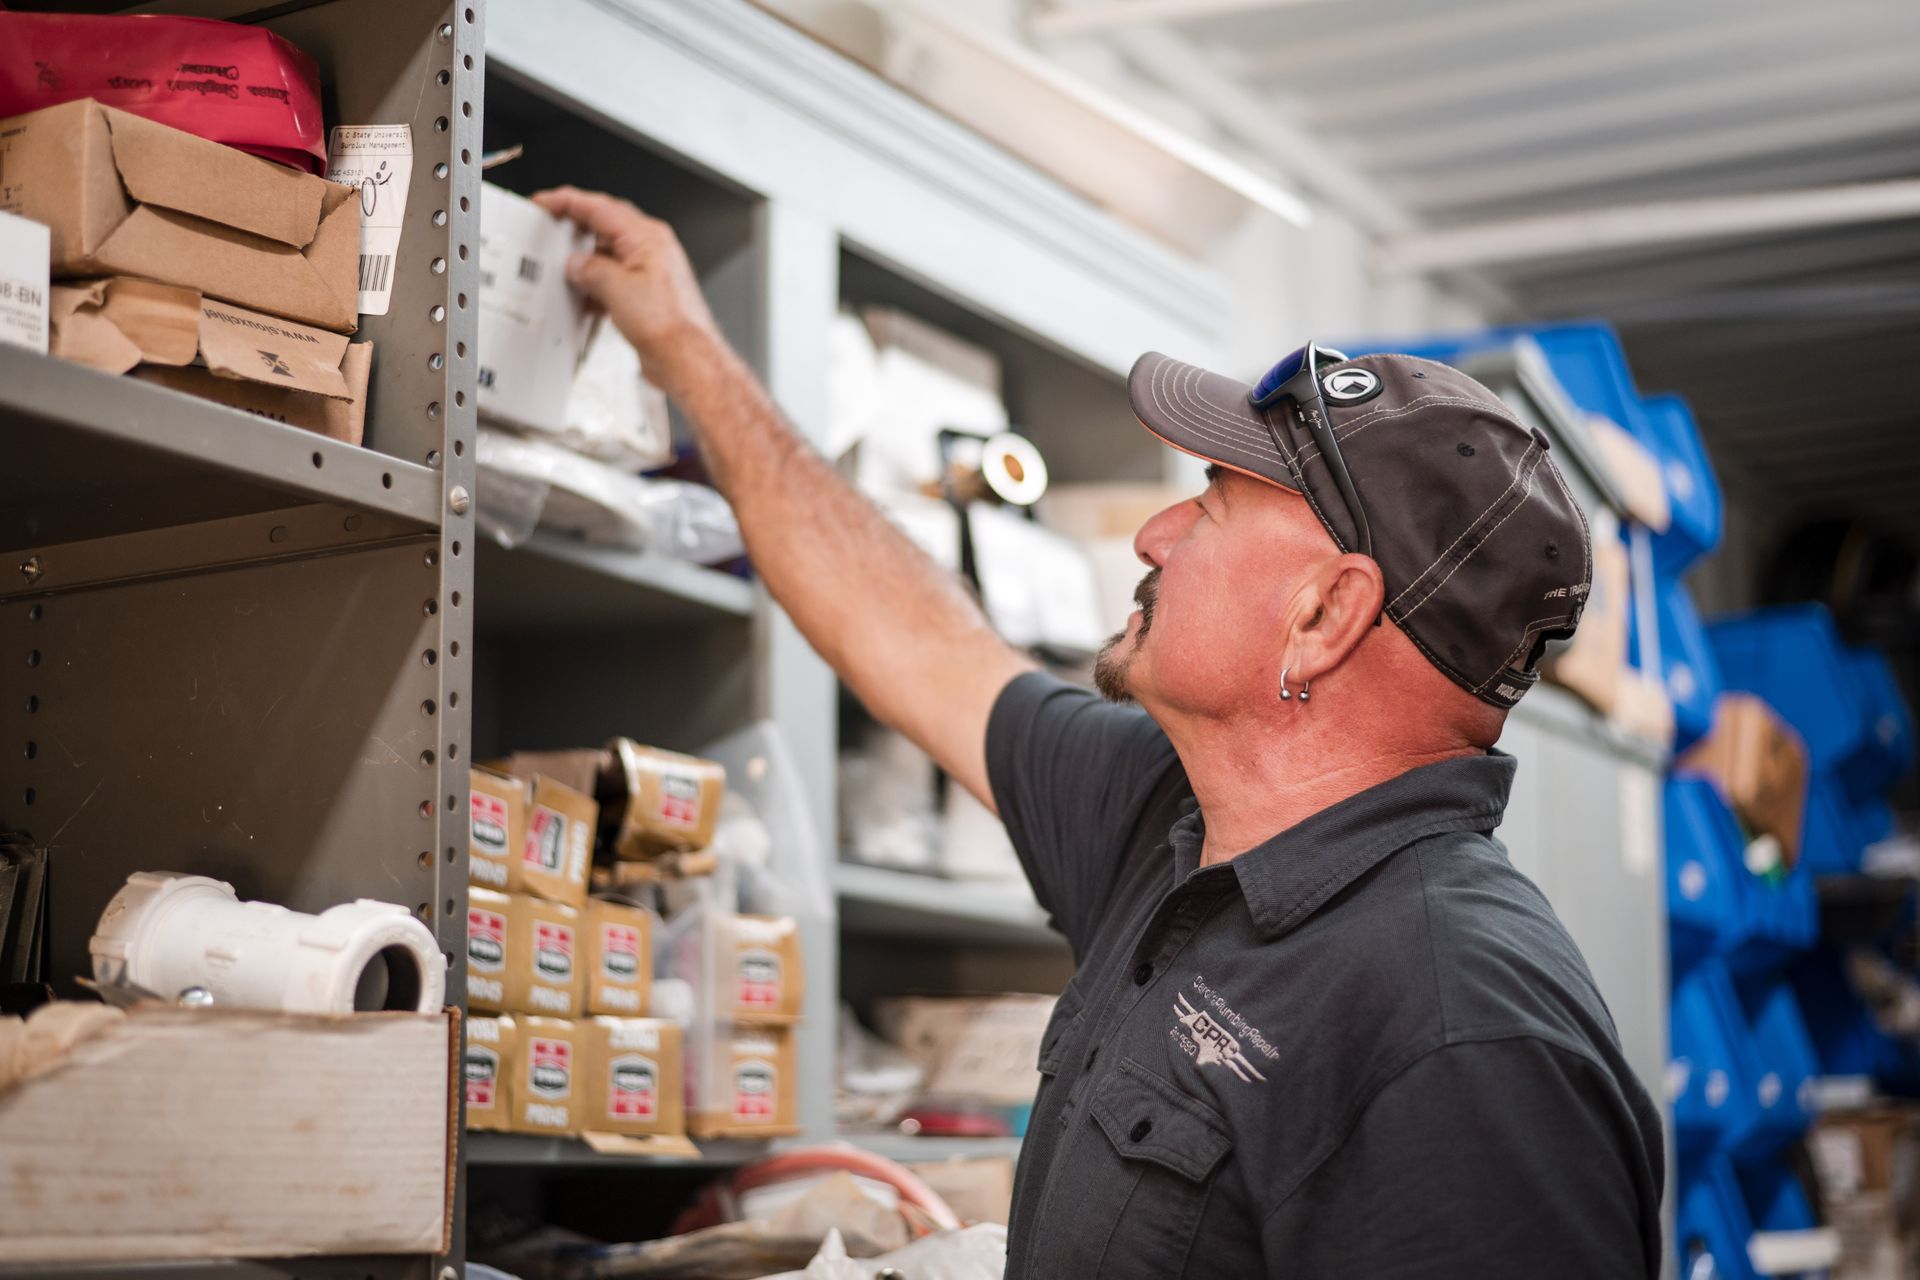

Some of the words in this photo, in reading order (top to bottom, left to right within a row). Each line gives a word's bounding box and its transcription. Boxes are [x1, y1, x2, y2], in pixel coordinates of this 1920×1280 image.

[352, 131, 371, 139] State
[374, 131, 409, 140] University
[340, 142, 366, 150] Surplus
[369, 142, 406, 150] Management
[1544, 587, 1567, 600] THE
[1192, 1015, 1230, 1053] CPR
[1215, 997, 1249, 1038] Plumbing
[1246, 1027, 1280, 1060] Repair
